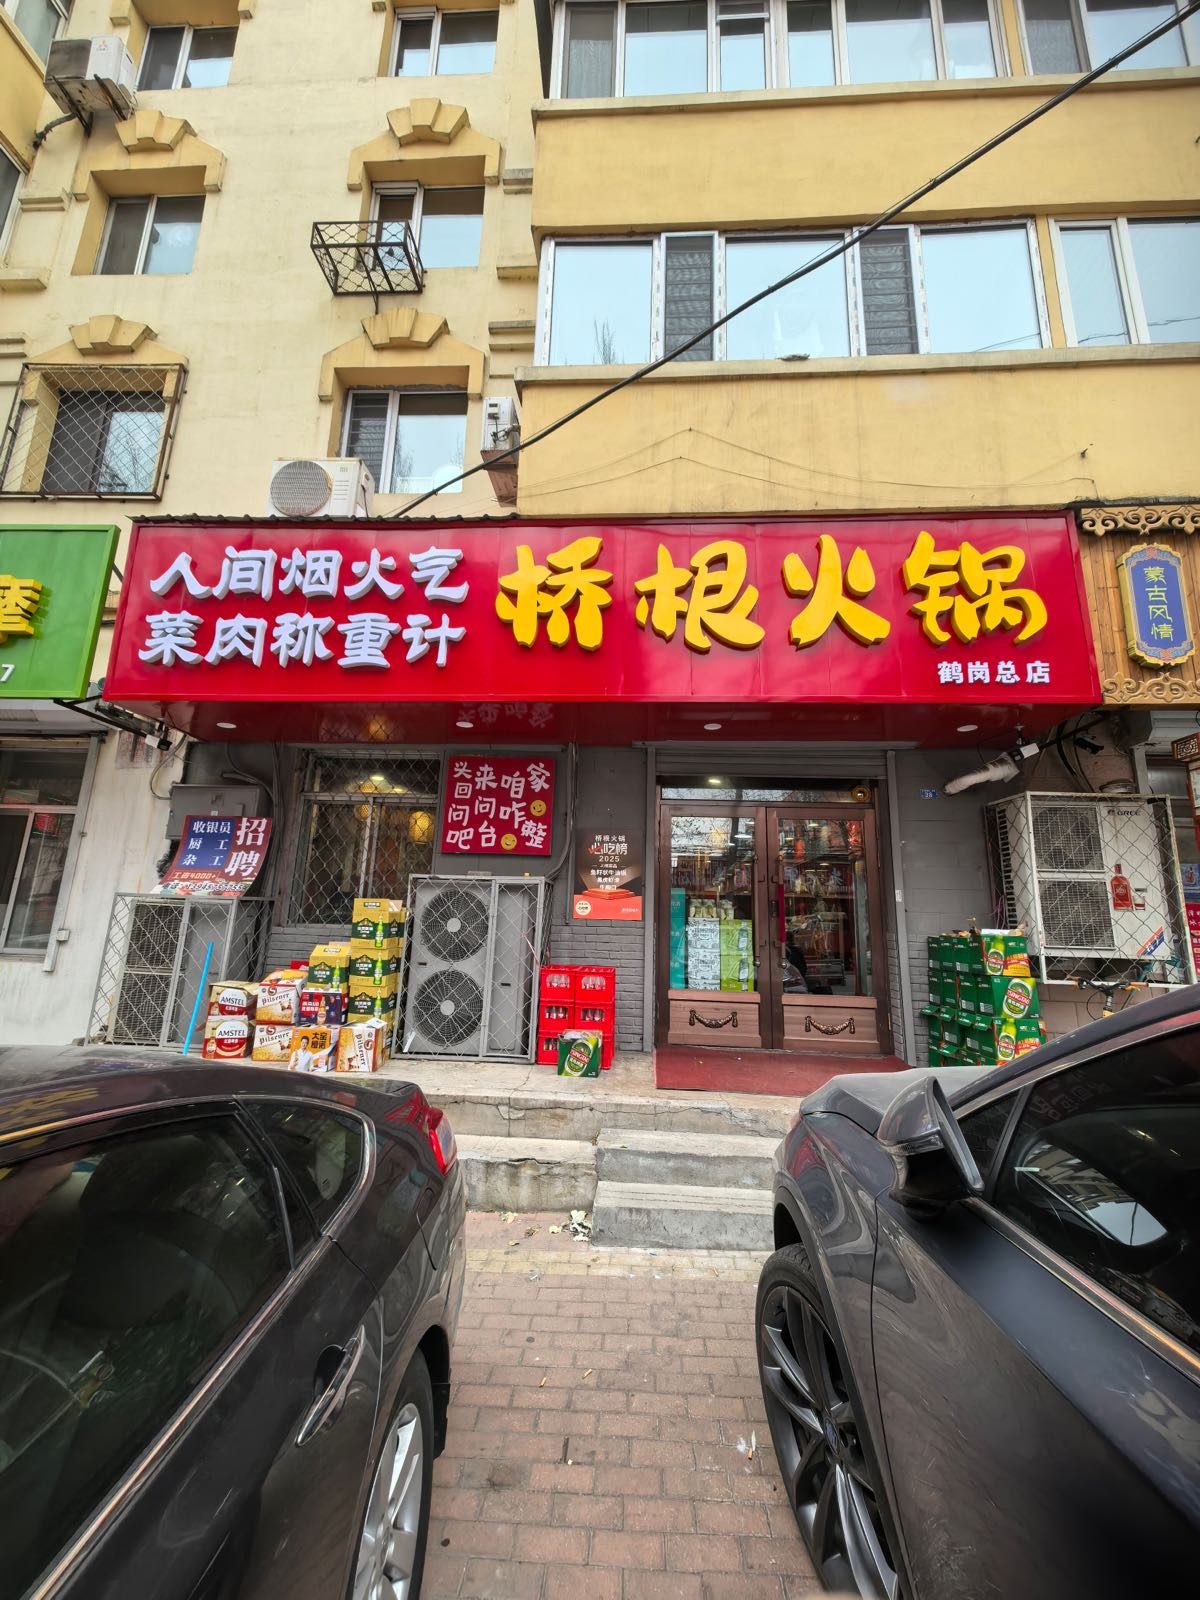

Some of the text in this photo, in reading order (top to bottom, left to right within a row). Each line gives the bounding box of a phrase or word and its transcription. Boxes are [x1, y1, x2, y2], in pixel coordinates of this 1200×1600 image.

[150, 546, 469, 603] 人间烟火气
[495, 530, 1049, 652] 桥根火锅
[1143, 565, 1174, 642] 蒙古风情
[138, 610, 467, 669] 菜肉称重计
[937, 660, 1050, 685] 鹤岗总店
[192, 821, 231, 834] 收银员
[225, 817, 267, 877] 招聘
[591, 842, 628, 855] 必吃榜
[599, 855, 620, 863] 2025
[220, 996, 245, 1006] AMSTEL
[262, 993, 289, 1005] Pilsener
[217, 1029, 245, 1037] AMSTEL
[259, 1031, 289, 1045] Pilsener
